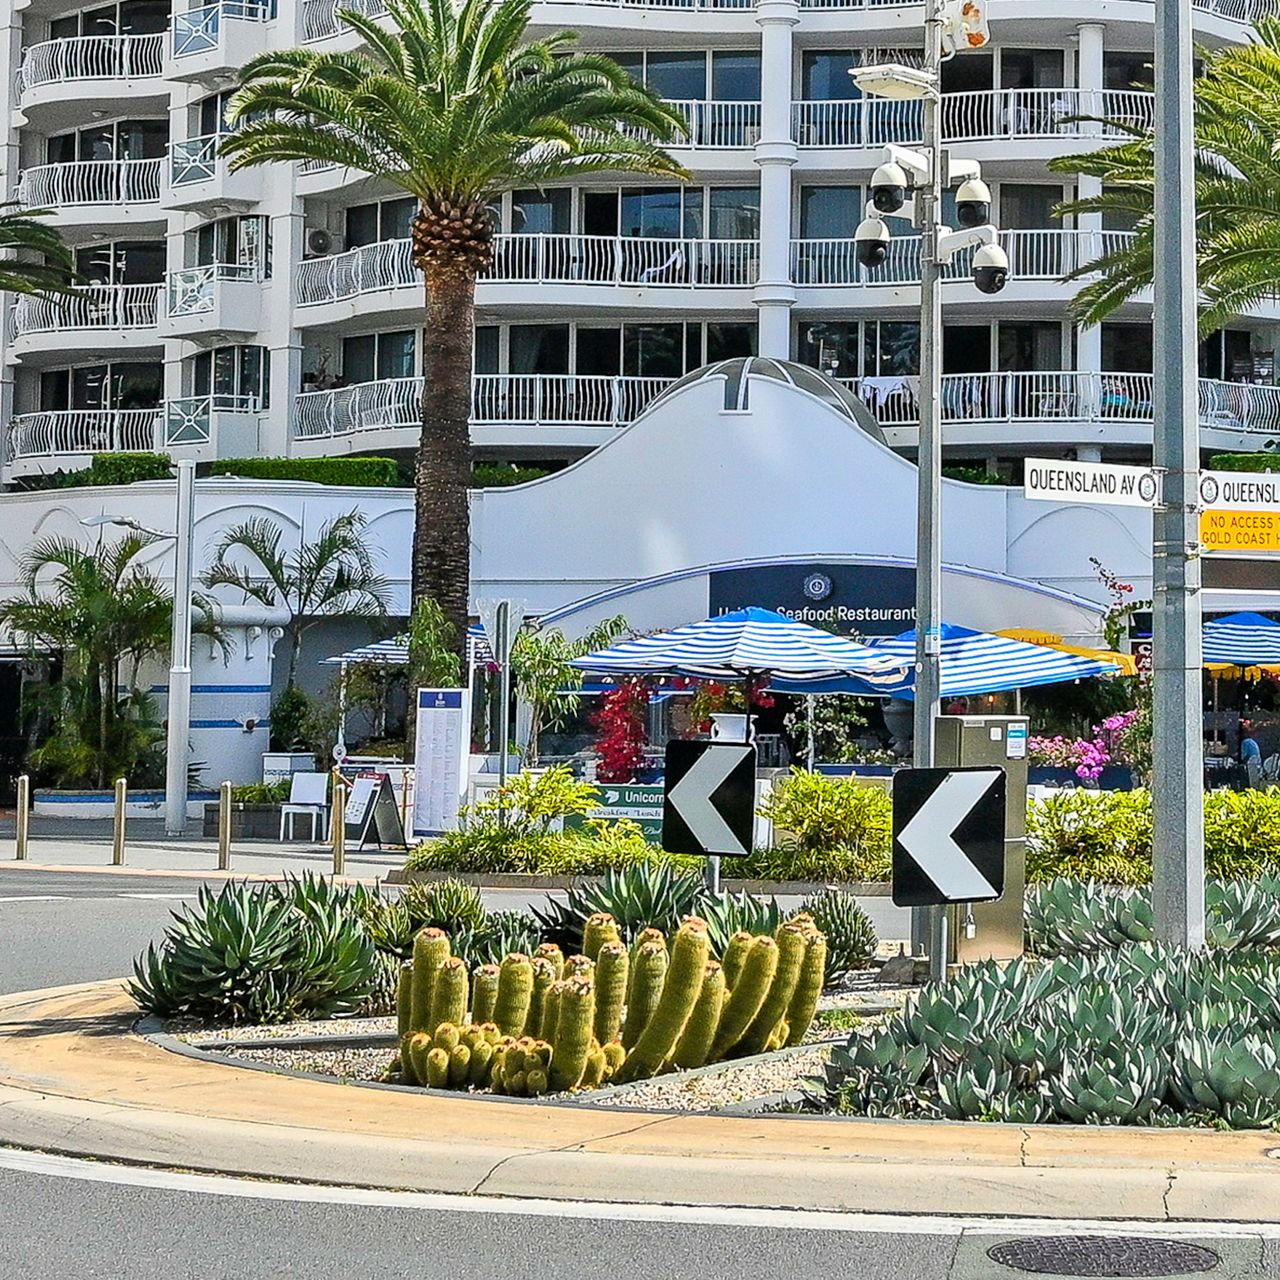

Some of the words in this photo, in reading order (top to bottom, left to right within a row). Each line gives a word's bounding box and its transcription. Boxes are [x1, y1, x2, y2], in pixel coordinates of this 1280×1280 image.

[1029, 468, 1117, 494] QUEENSLAND
[1120, 475, 1136, 495] AV
[1210, 516, 1226, 528] NO
[1231, 516, 1274, 529] ACCESS
[1202, 531, 1232, 545] GOLD
[1235, 532, 1271, 545] COAST
[776, 606, 835, 621] Seafood
[838, 606, 917, 620] Restaurant
[625, 791, 665, 803] Unicorn
